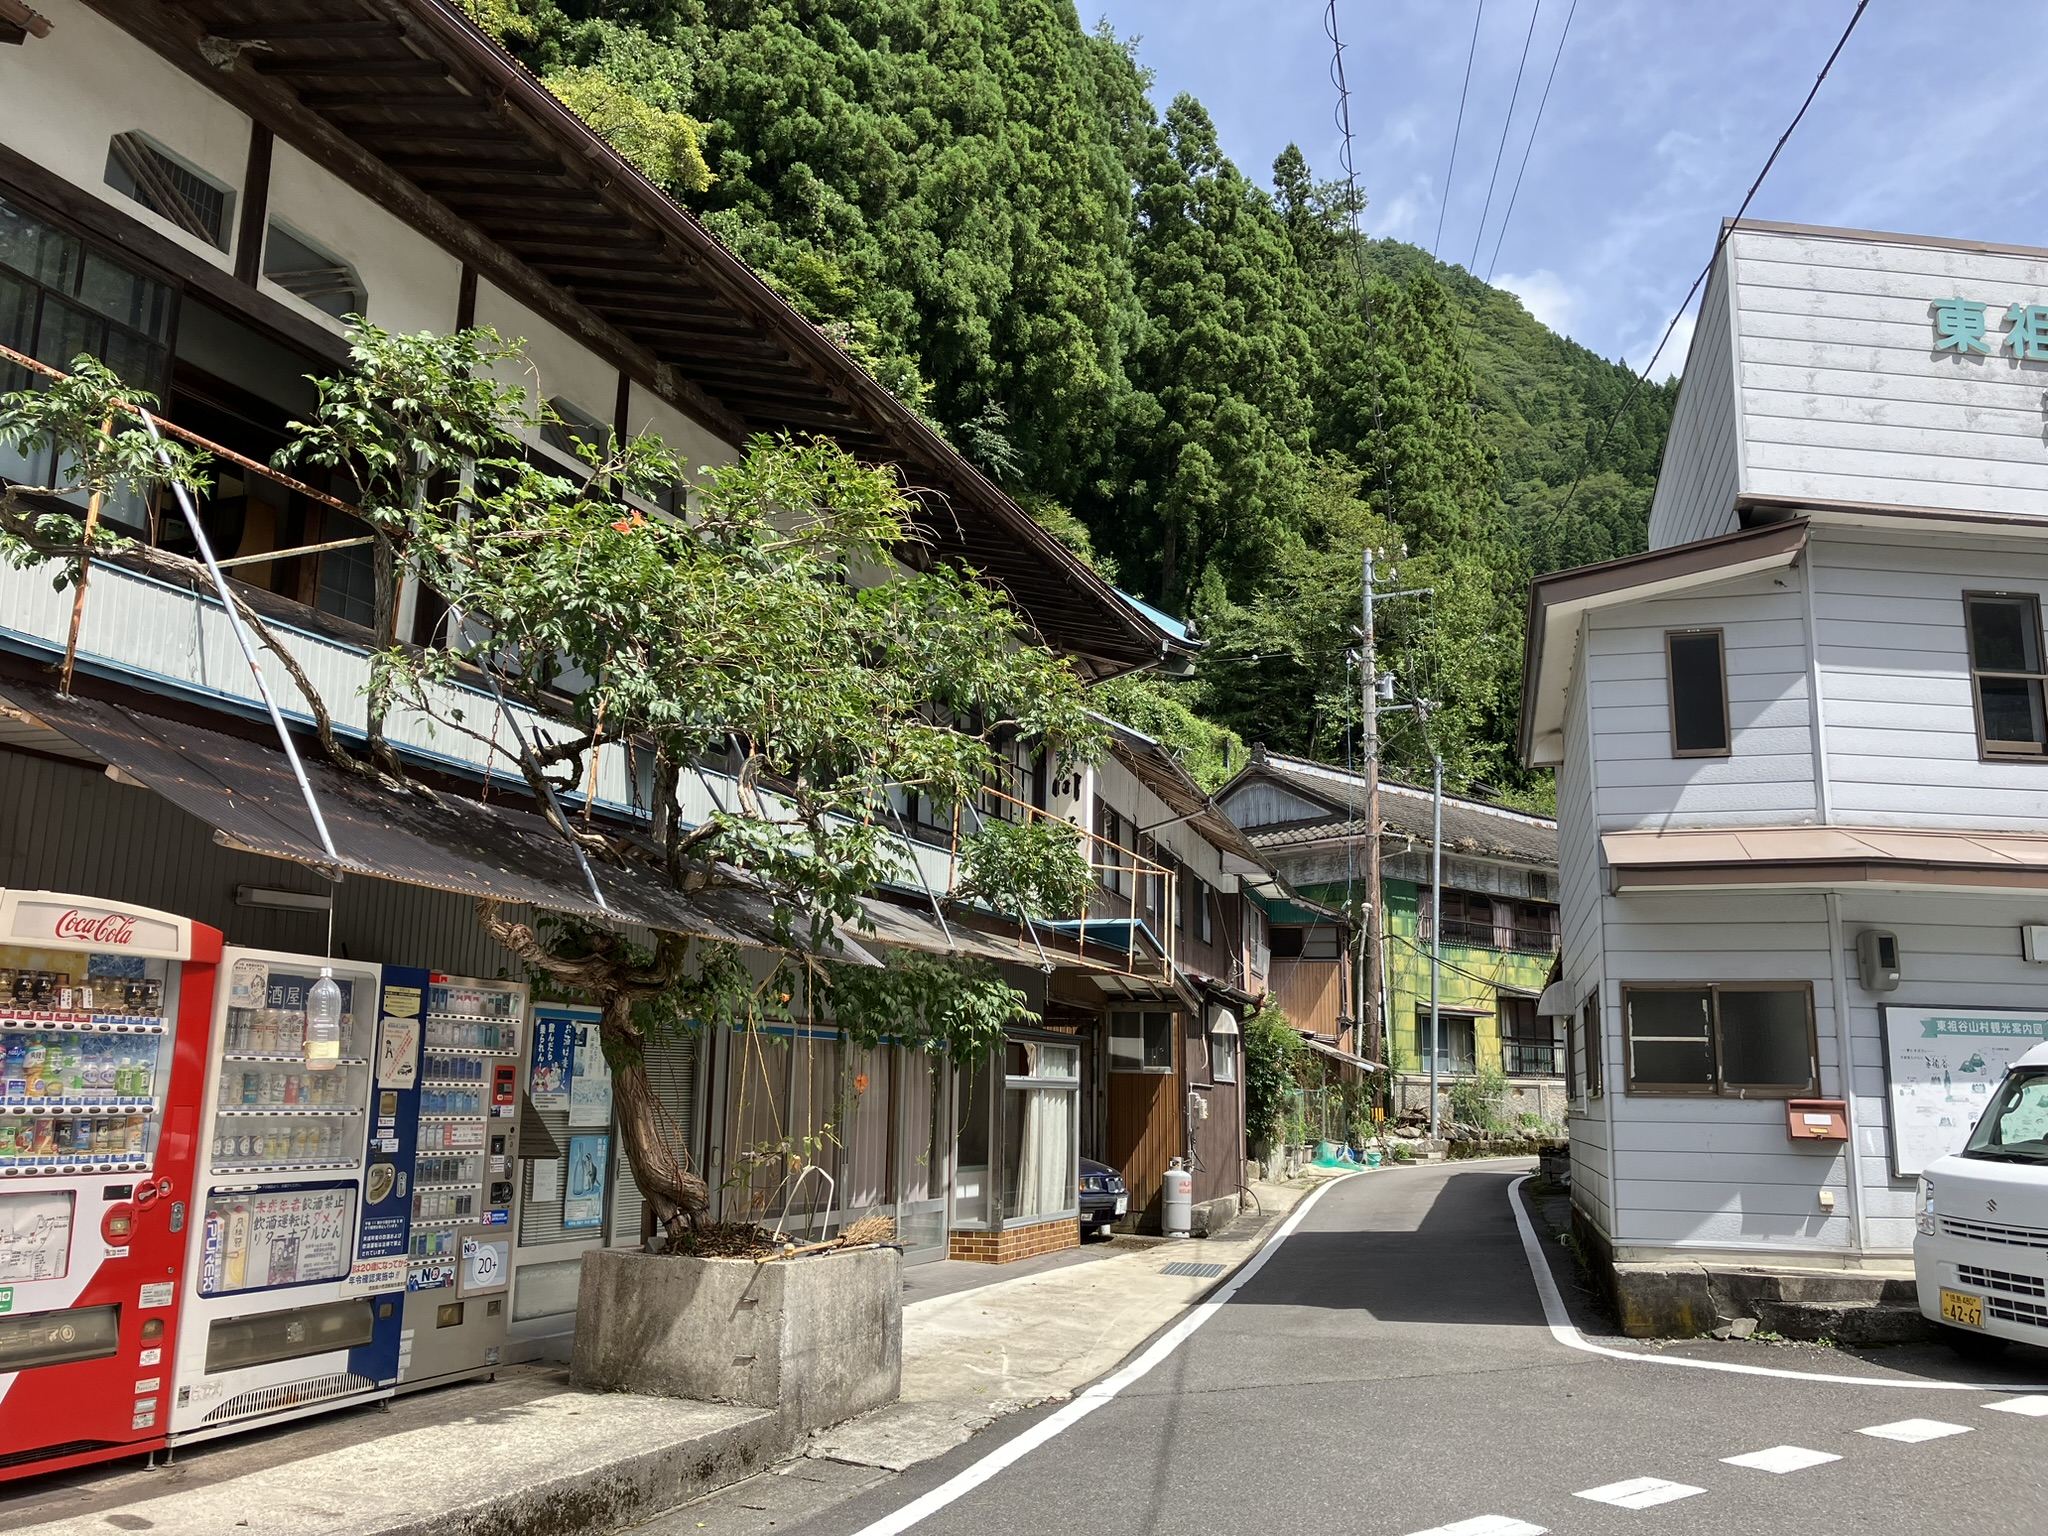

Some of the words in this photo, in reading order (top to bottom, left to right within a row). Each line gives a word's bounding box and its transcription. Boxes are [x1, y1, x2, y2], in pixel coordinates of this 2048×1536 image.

[55, 909, 138, 944] Coca-Cola
[268, 985, 311, 1006] 酒屋
[1936, 1020, 2043, 1035] 東祖谷山村観光案内図
[255, 1194, 344, 1214] 未成年者飲酒禁止
[478, 1257, 497, 1274] 20+
[1950, 1304, 1982, 1326] 42-67
